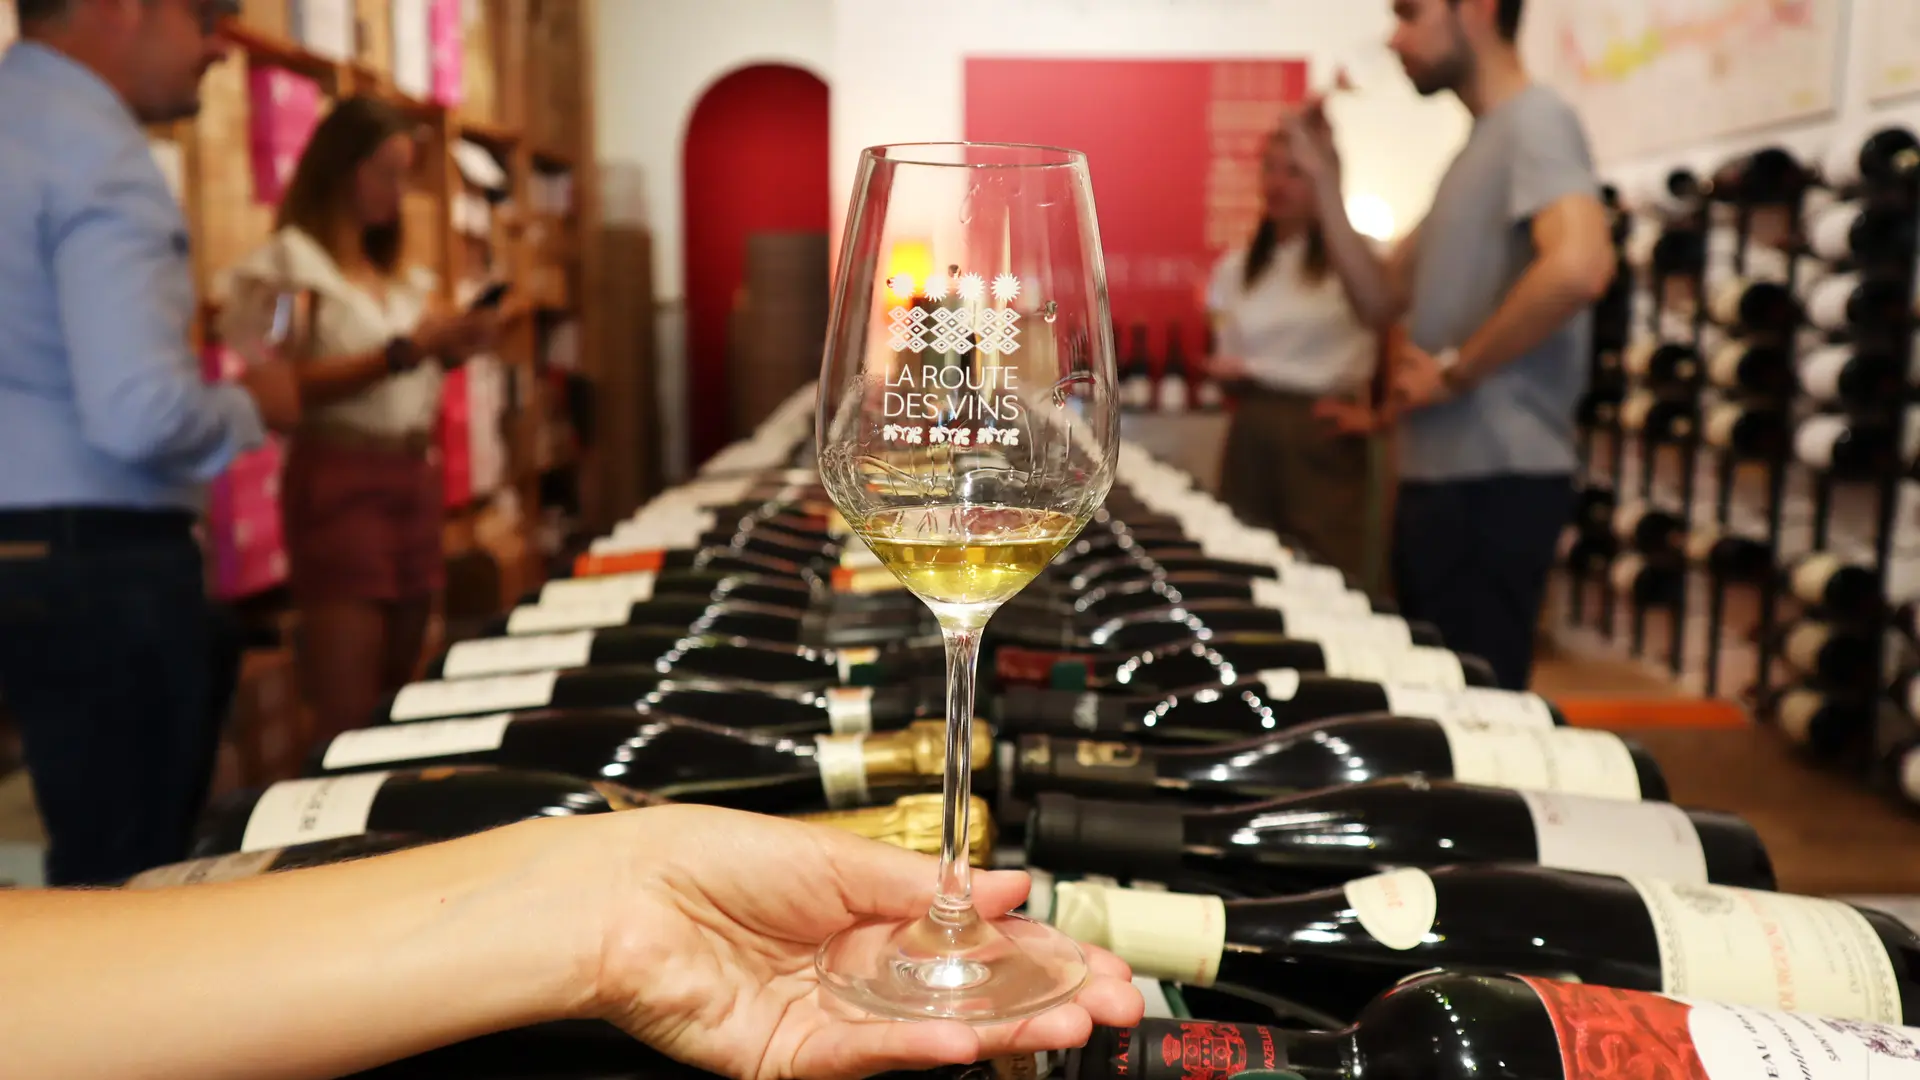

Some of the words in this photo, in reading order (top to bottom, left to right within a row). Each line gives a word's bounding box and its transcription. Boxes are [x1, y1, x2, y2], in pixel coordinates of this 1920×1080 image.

[885, 364, 915, 387] LA
[922, 365, 1019, 390] ROUTE
[884, 393, 938, 419] DES
[946, 394, 1019, 421] VINS
